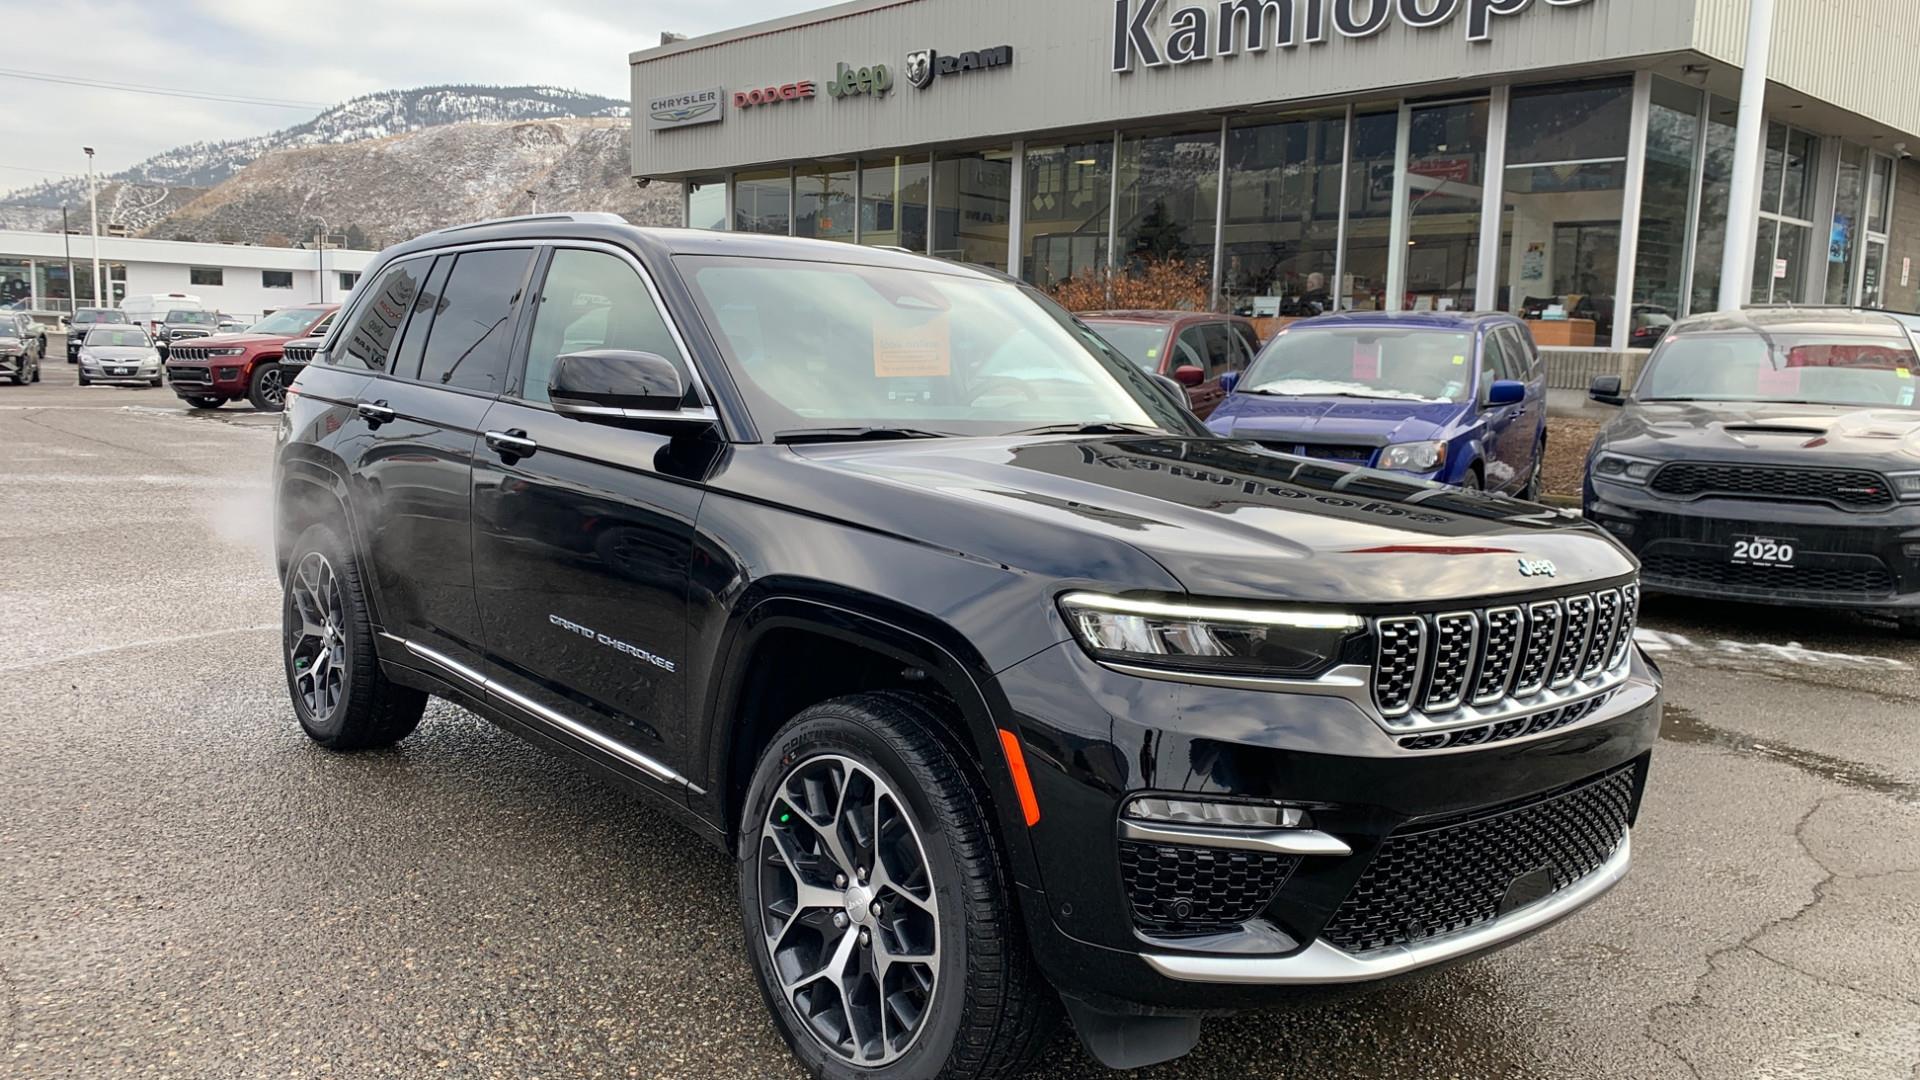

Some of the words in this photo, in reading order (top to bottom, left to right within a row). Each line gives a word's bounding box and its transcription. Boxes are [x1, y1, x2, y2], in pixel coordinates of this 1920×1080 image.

[1112, 0, 1594, 73] Kamloop
[935, 45, 1012, 76] RAM
[734, 81, 816, 110] DODGE
[827, 62, 894, 99] Jeep
[651, 91, 716, 111] CHRYSLER
[1734, 541, 1793, 562] 2020
[1518, 557, 1556, 577] Jeep
[549, 614, 595, 639] GRAND
[597, 633, 676, 673] CHEROKEE
